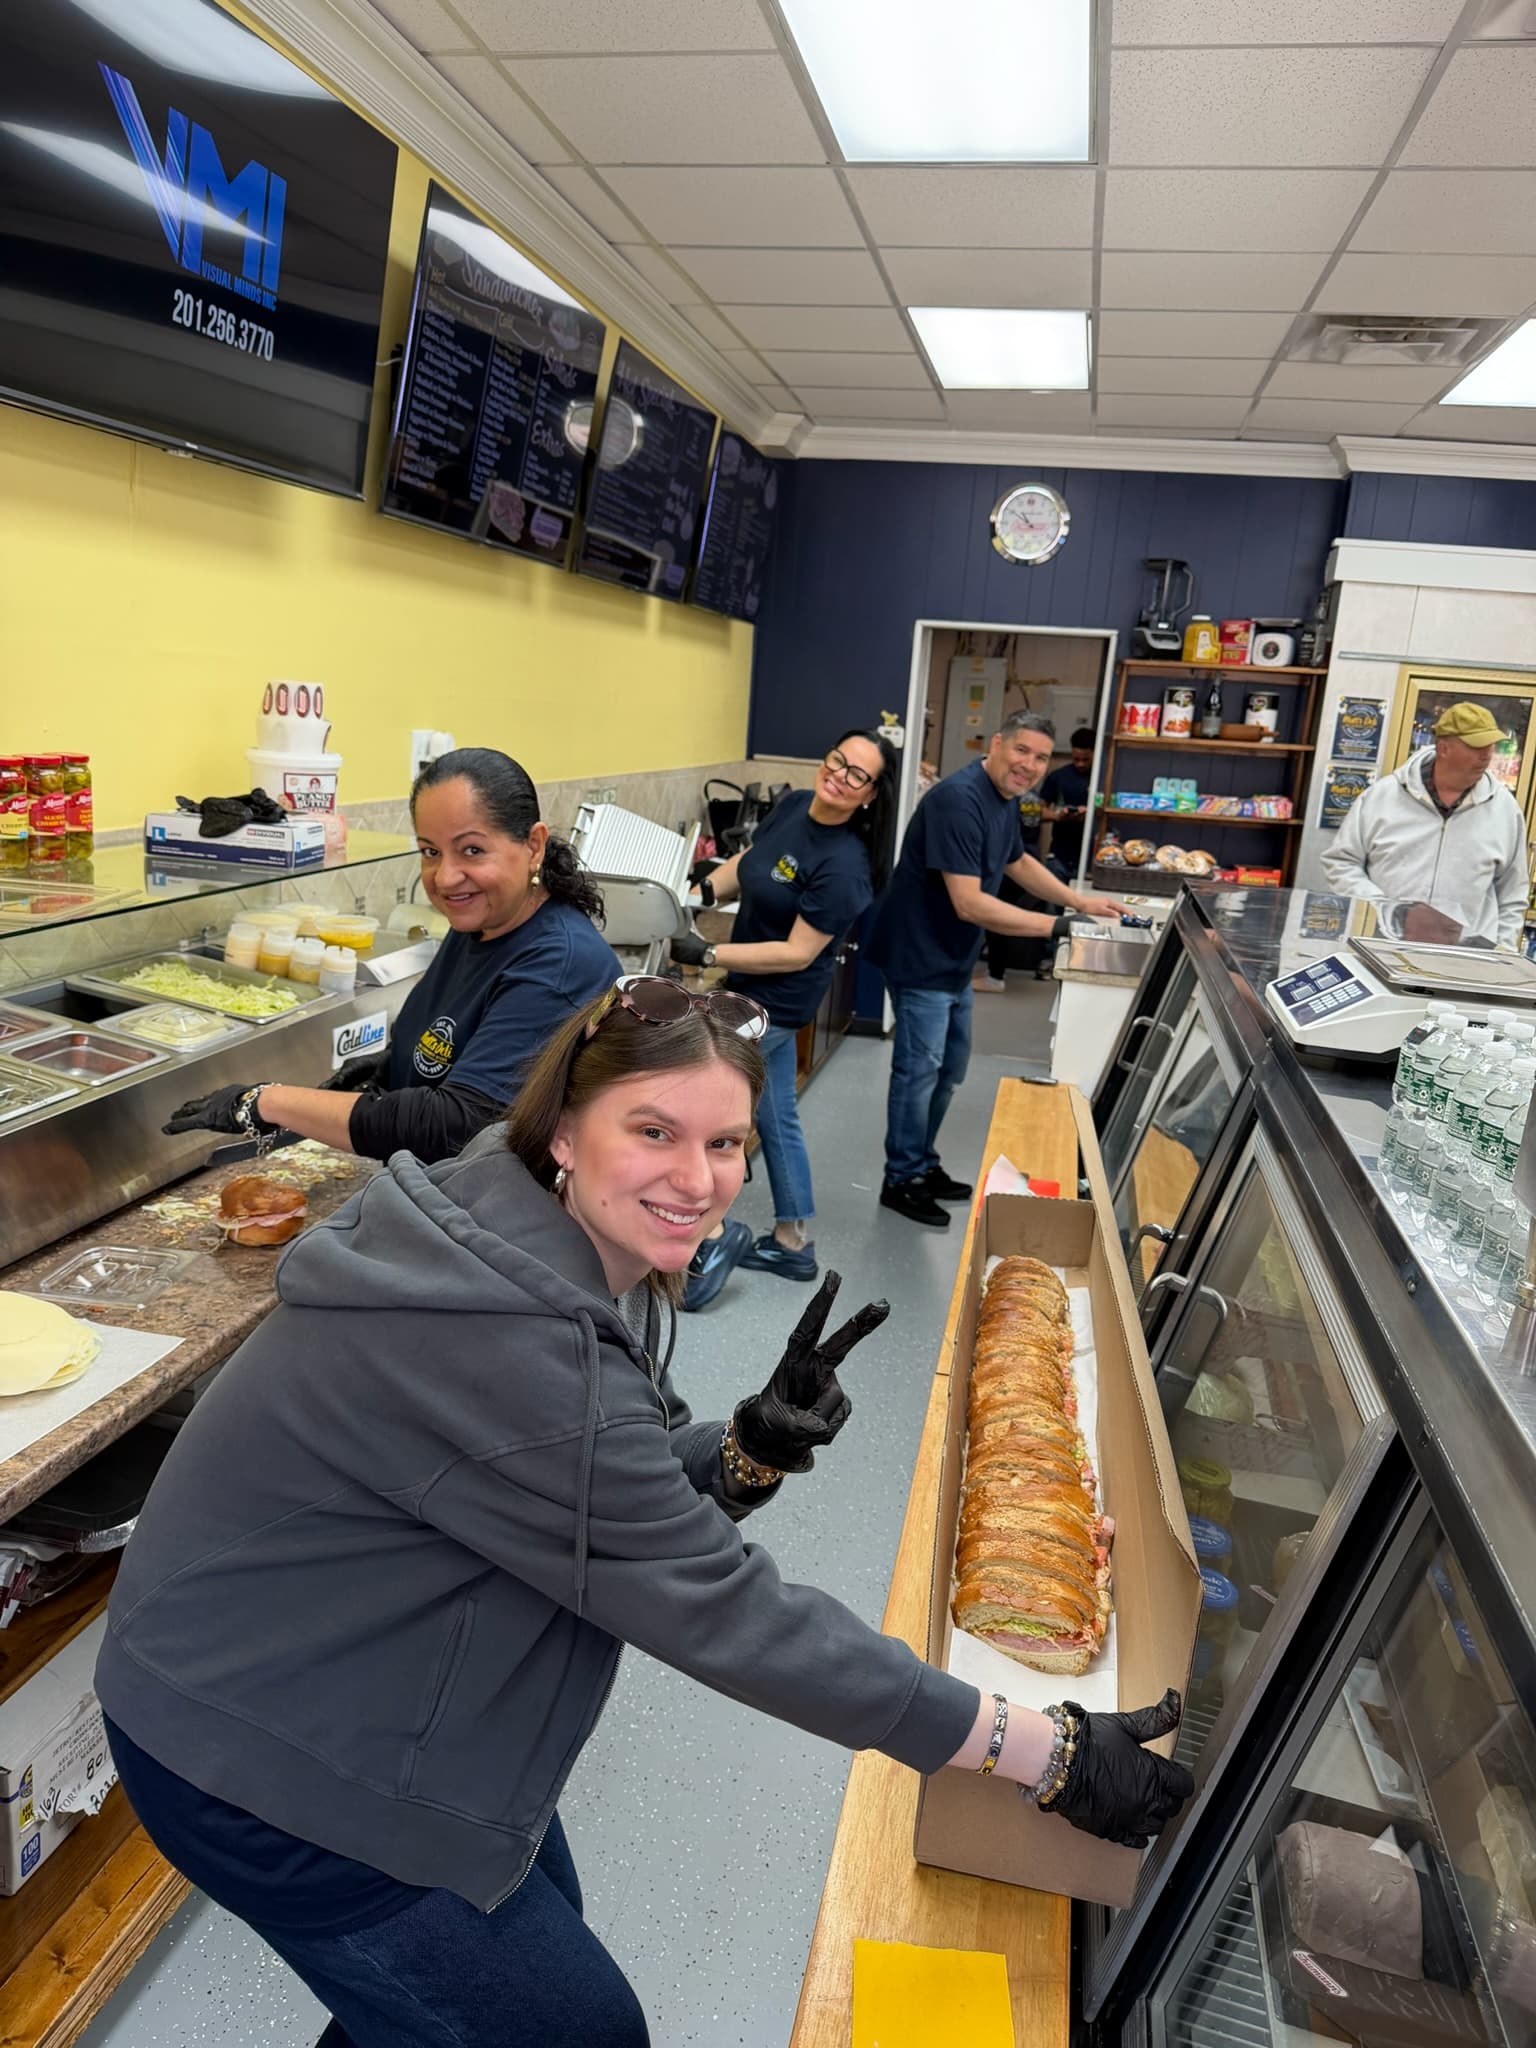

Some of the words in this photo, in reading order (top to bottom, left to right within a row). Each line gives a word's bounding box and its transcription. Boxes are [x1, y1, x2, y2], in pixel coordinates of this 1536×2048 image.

[201, 260, 233, 291] VISUAL
[233, 275, 262, 306] MINDS
[262, 288, 279, 312] INC
[172, 288, 275, 362] 201.256.3770
[531, 420, 565, 458] Extras
[337, 1024, 385, 1057] Coldline
[23, 1835, 38, 1860] 100
